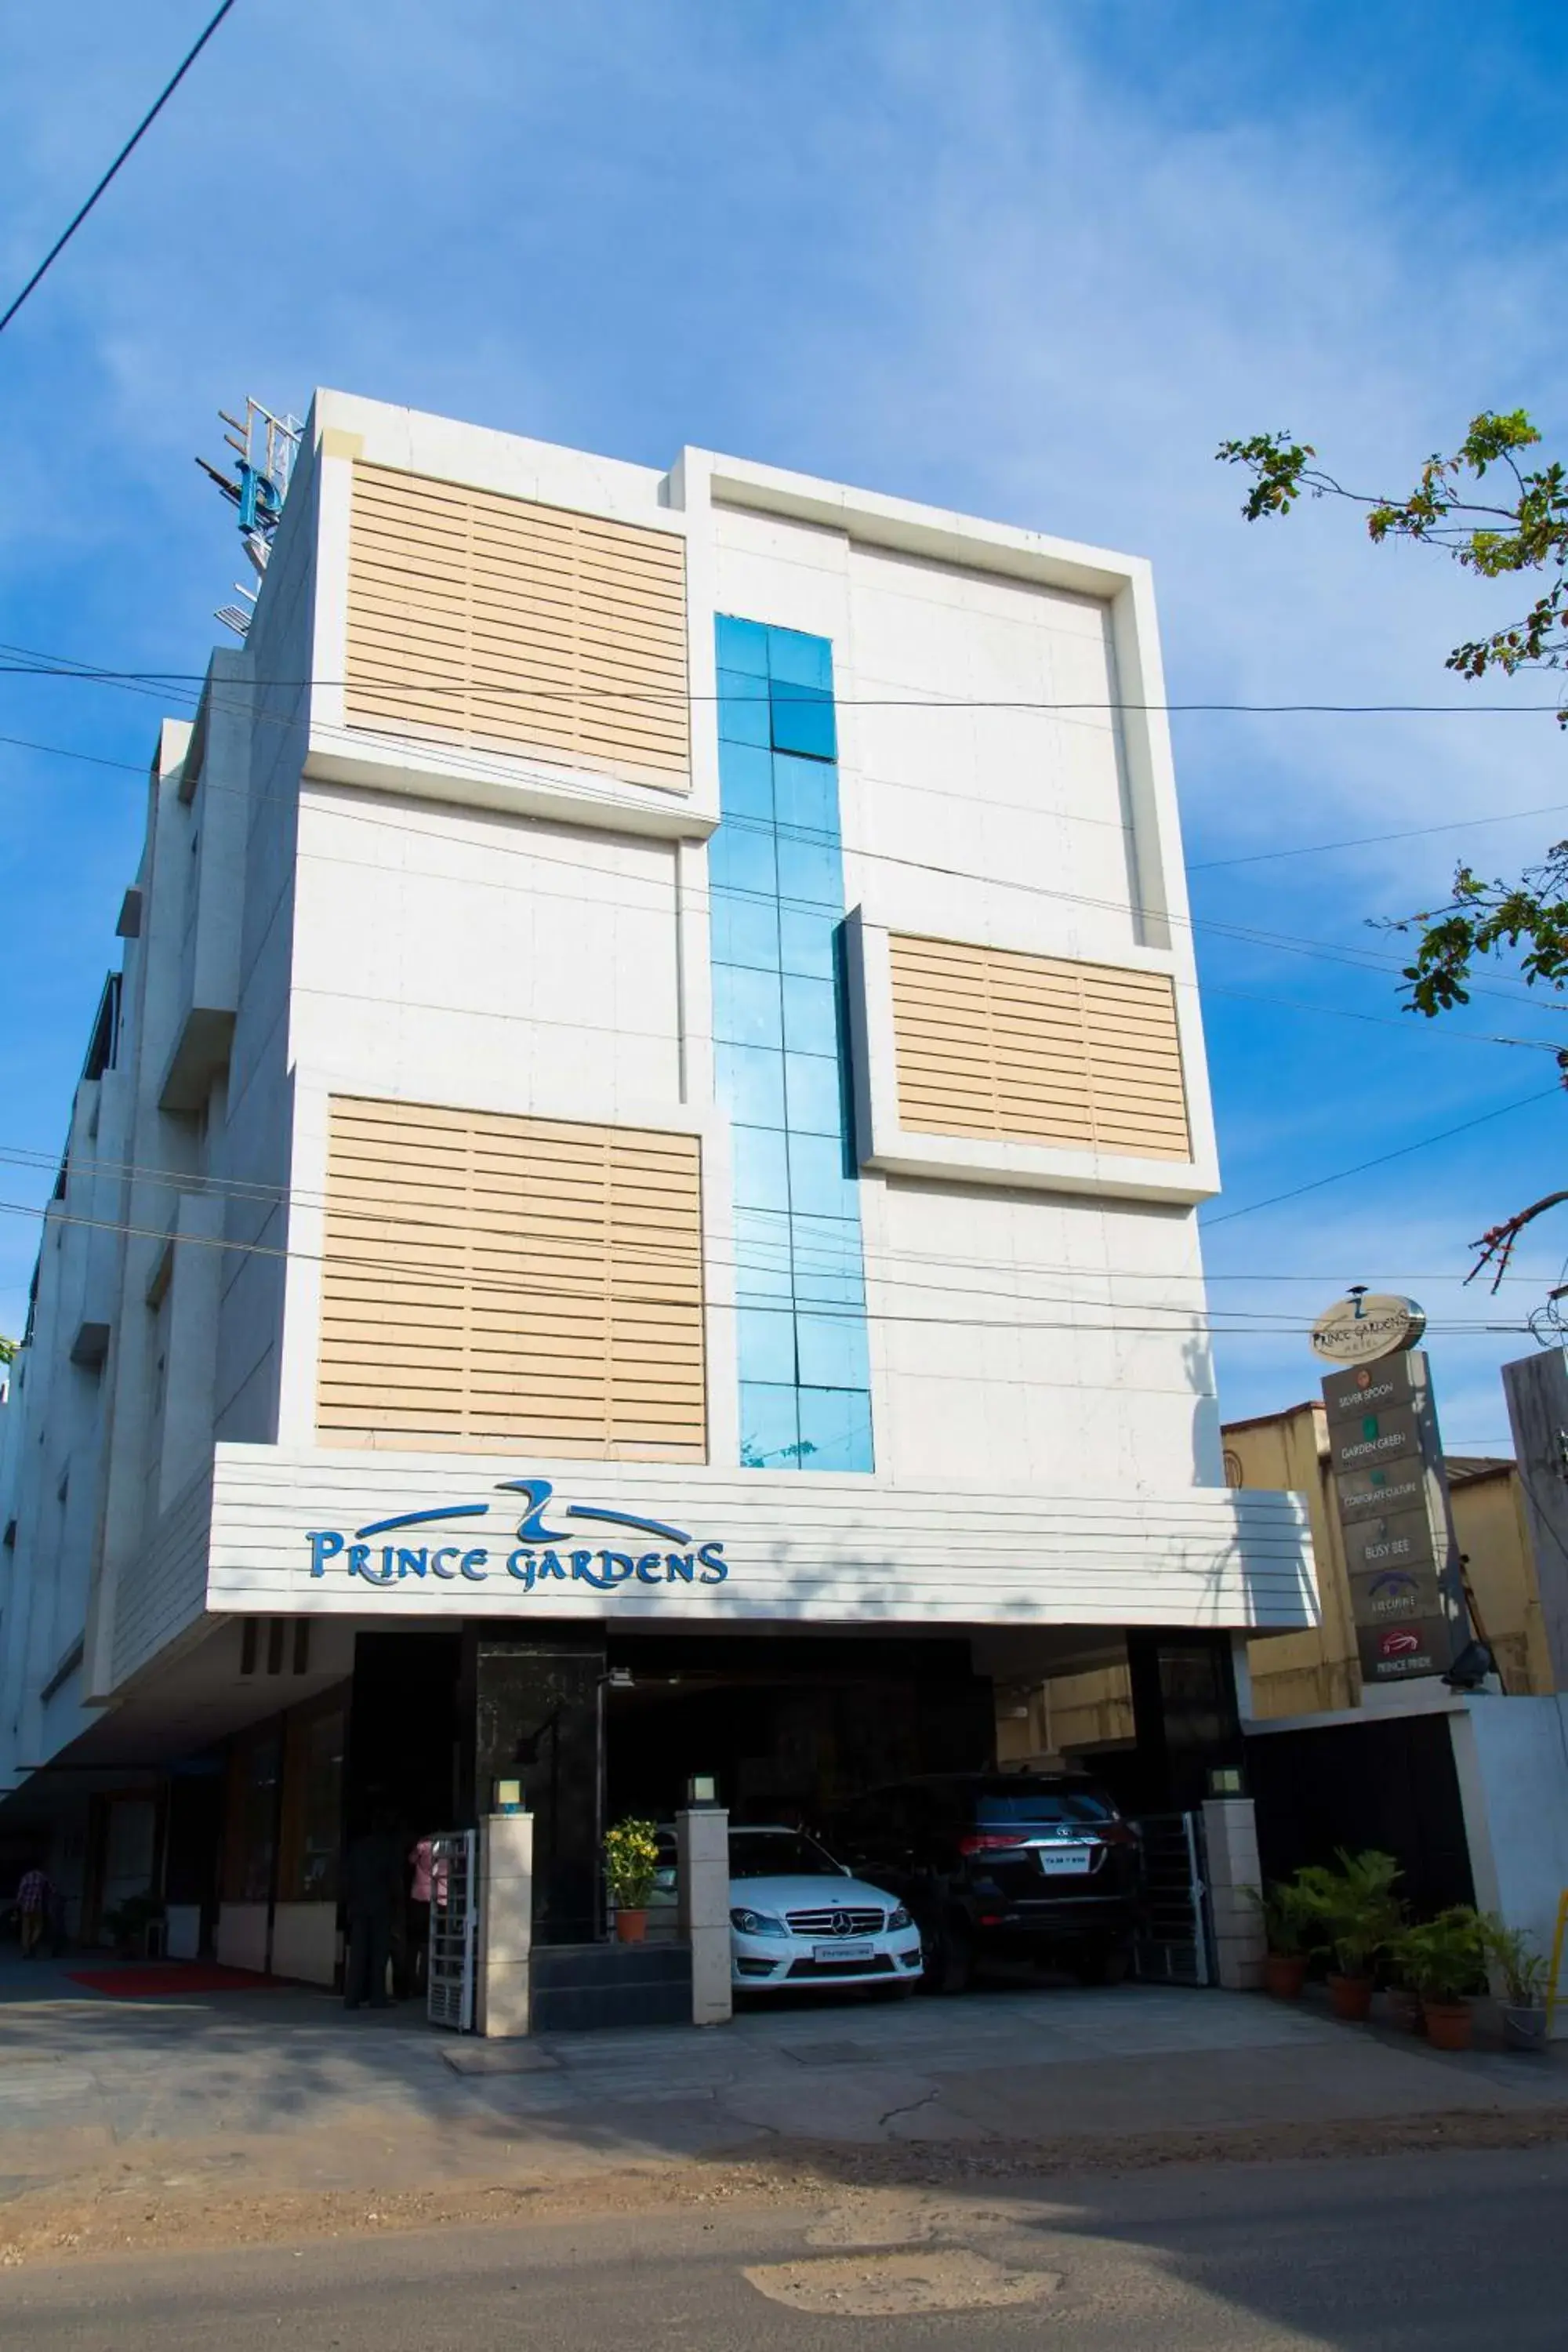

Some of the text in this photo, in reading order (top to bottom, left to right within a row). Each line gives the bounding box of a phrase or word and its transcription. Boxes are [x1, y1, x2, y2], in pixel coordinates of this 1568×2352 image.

[1312, 1308, 1410, 1348] PRINCE GARDENS
[1338, 1381, 1394, 1407] SILVER SPOON
[1341, 1432, 1406, 1459] GARDEN GREEN
[305, 1530, 729, 1592] PRINCE GARDENS
[1365, 1538, 1410, 1559] BUSY BEE
[1377, 1659, 1406, 1672] PRINCE
